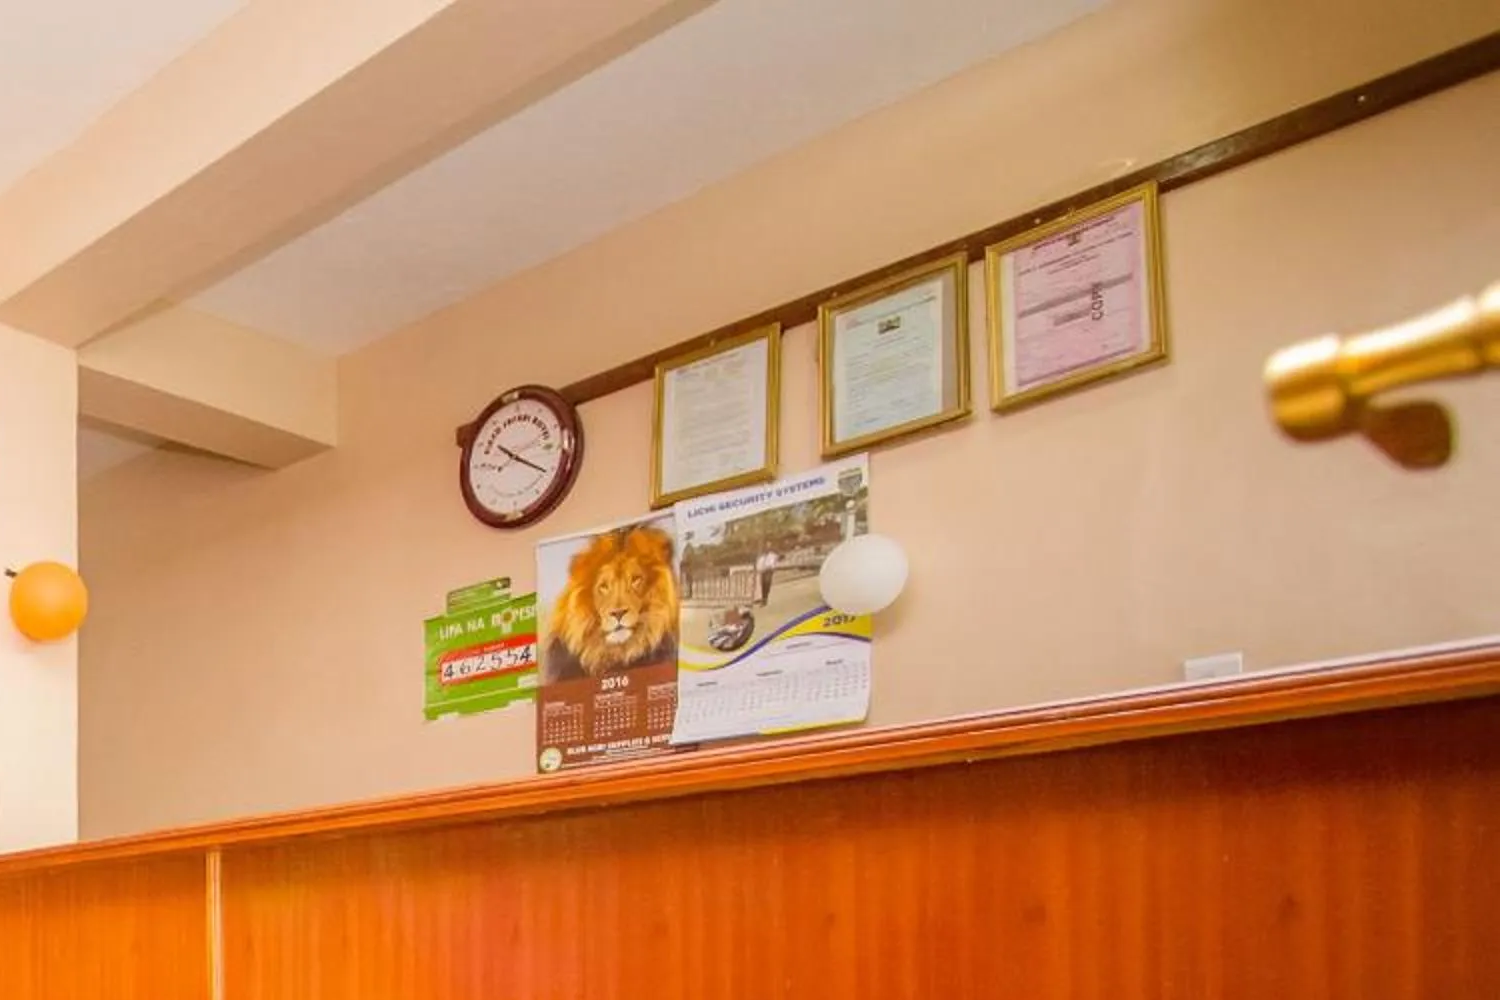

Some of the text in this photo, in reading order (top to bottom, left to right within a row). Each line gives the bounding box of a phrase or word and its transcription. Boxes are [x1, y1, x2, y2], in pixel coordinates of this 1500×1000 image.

[718, 491, 773, 511] SECURITY
[775, 476, 825, 498] SYSTEMS
[467, 616, 485, 633] NA
[601, 675, 629, 690] 2016
